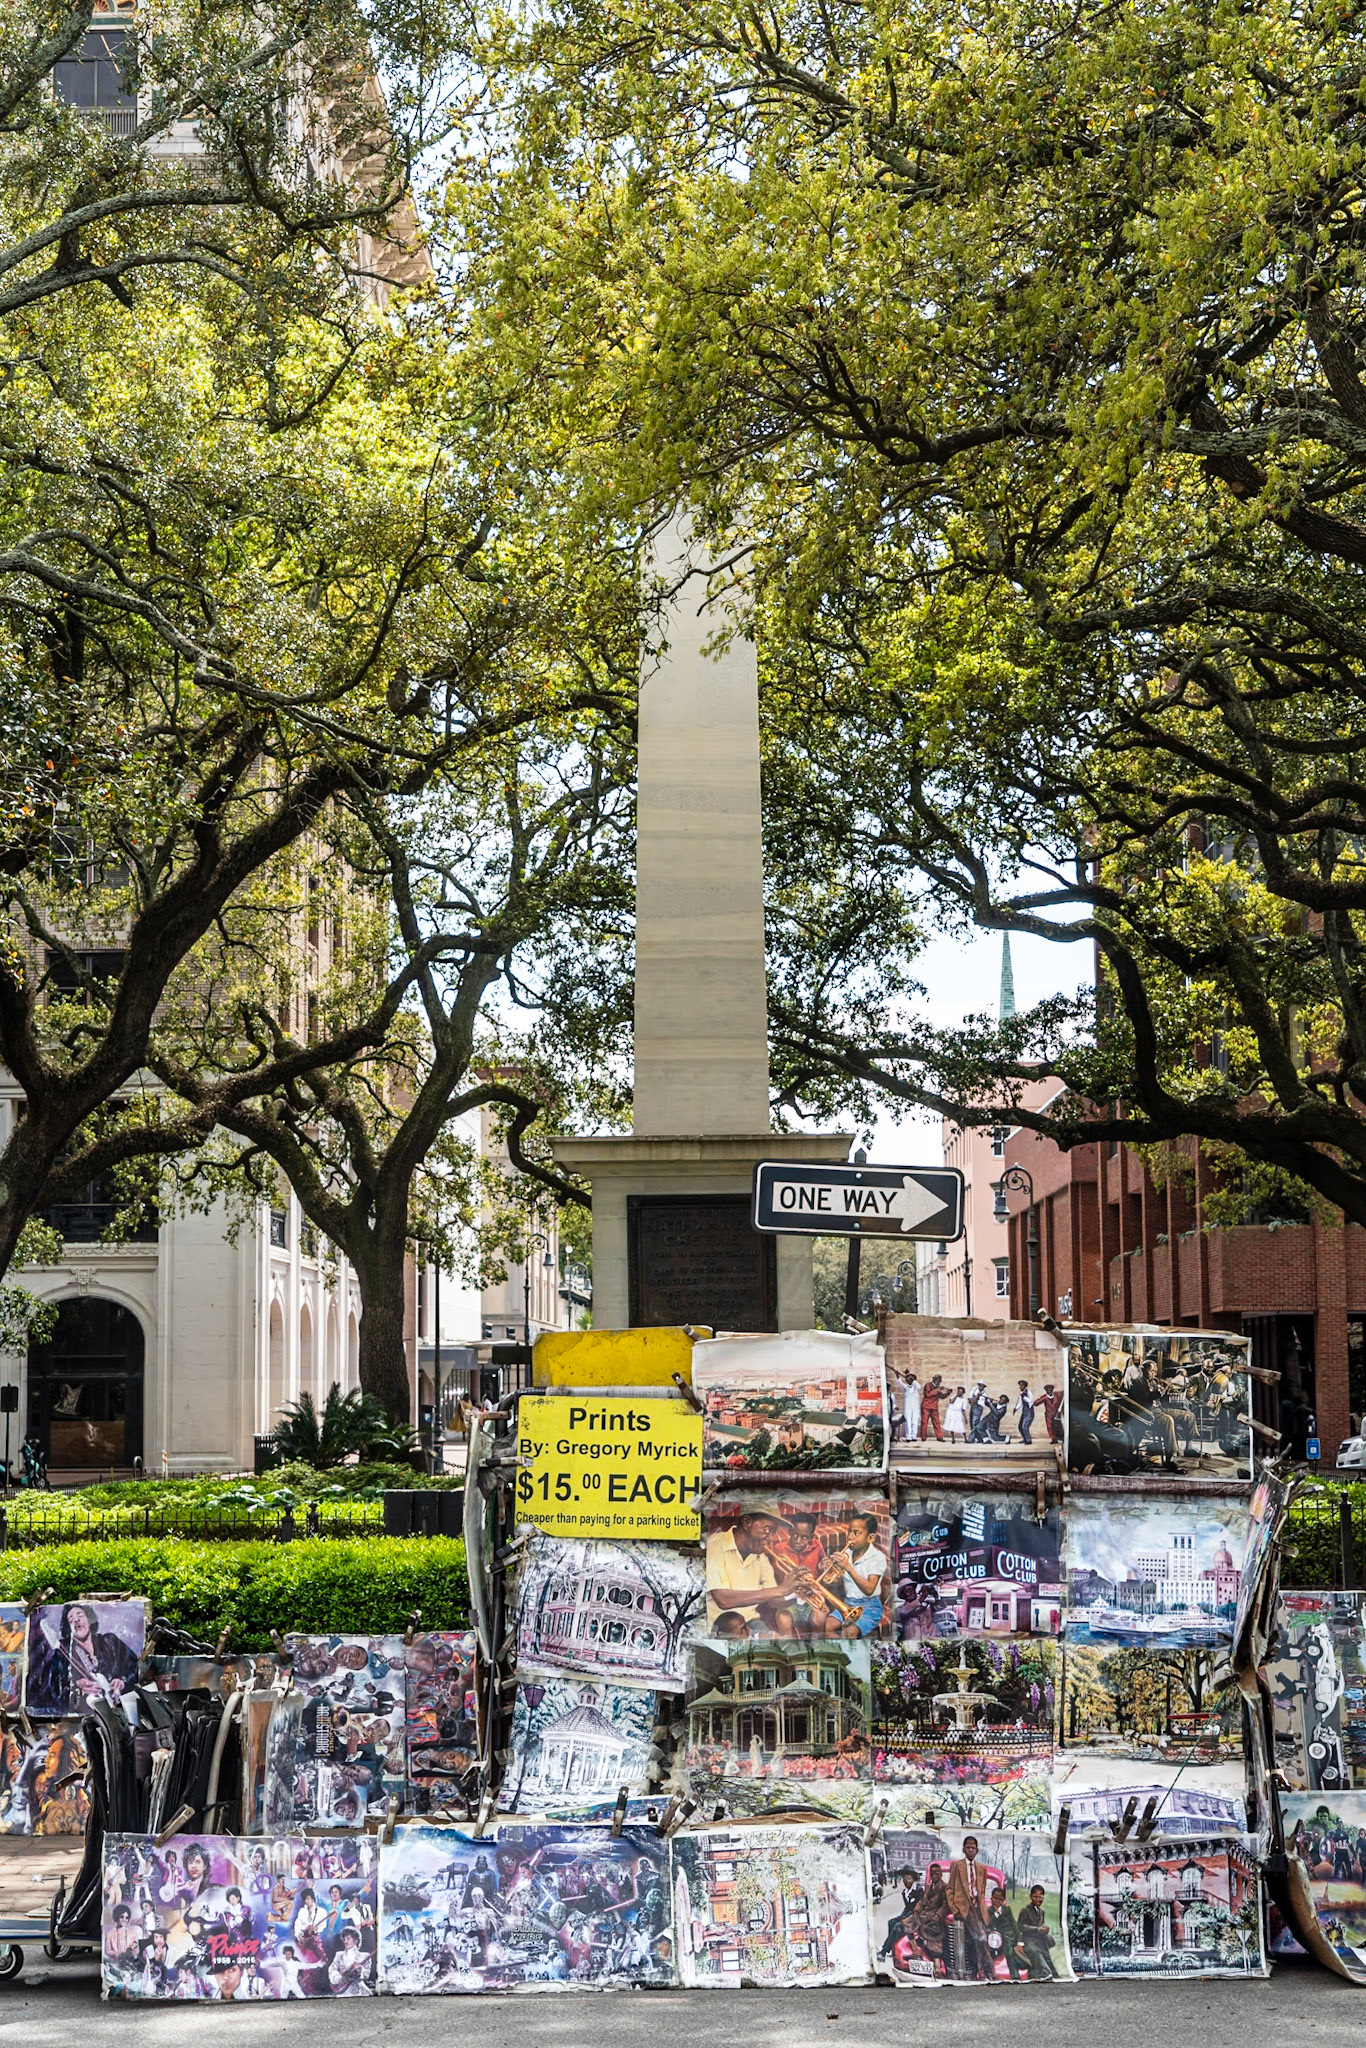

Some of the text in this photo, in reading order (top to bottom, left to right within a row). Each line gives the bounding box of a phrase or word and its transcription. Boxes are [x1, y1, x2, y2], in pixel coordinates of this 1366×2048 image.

[780, 1185, 898, 1214] ONE WAY
[569, 1407, 651, 1431] Prints
[520, 1439, 698, 1461] By: Gregory Myrick
[608, 1474, 700, 1504] EACH
[515, 1511, 699, 1528] Cheaper than paying for a parking ticket
[932, 1525, 949, 1542] CLUB
[923, 1552, 967, 1580] COTTON
[955, 1565, 986, 1579] CLUB
[997, 1550, 1037, 1579] COTTON
[1015, 1570, 1038, 1584] CLUB
[207, 1933, 260, 1961] Prince
[212, 1957, 231, 1965] 1958
